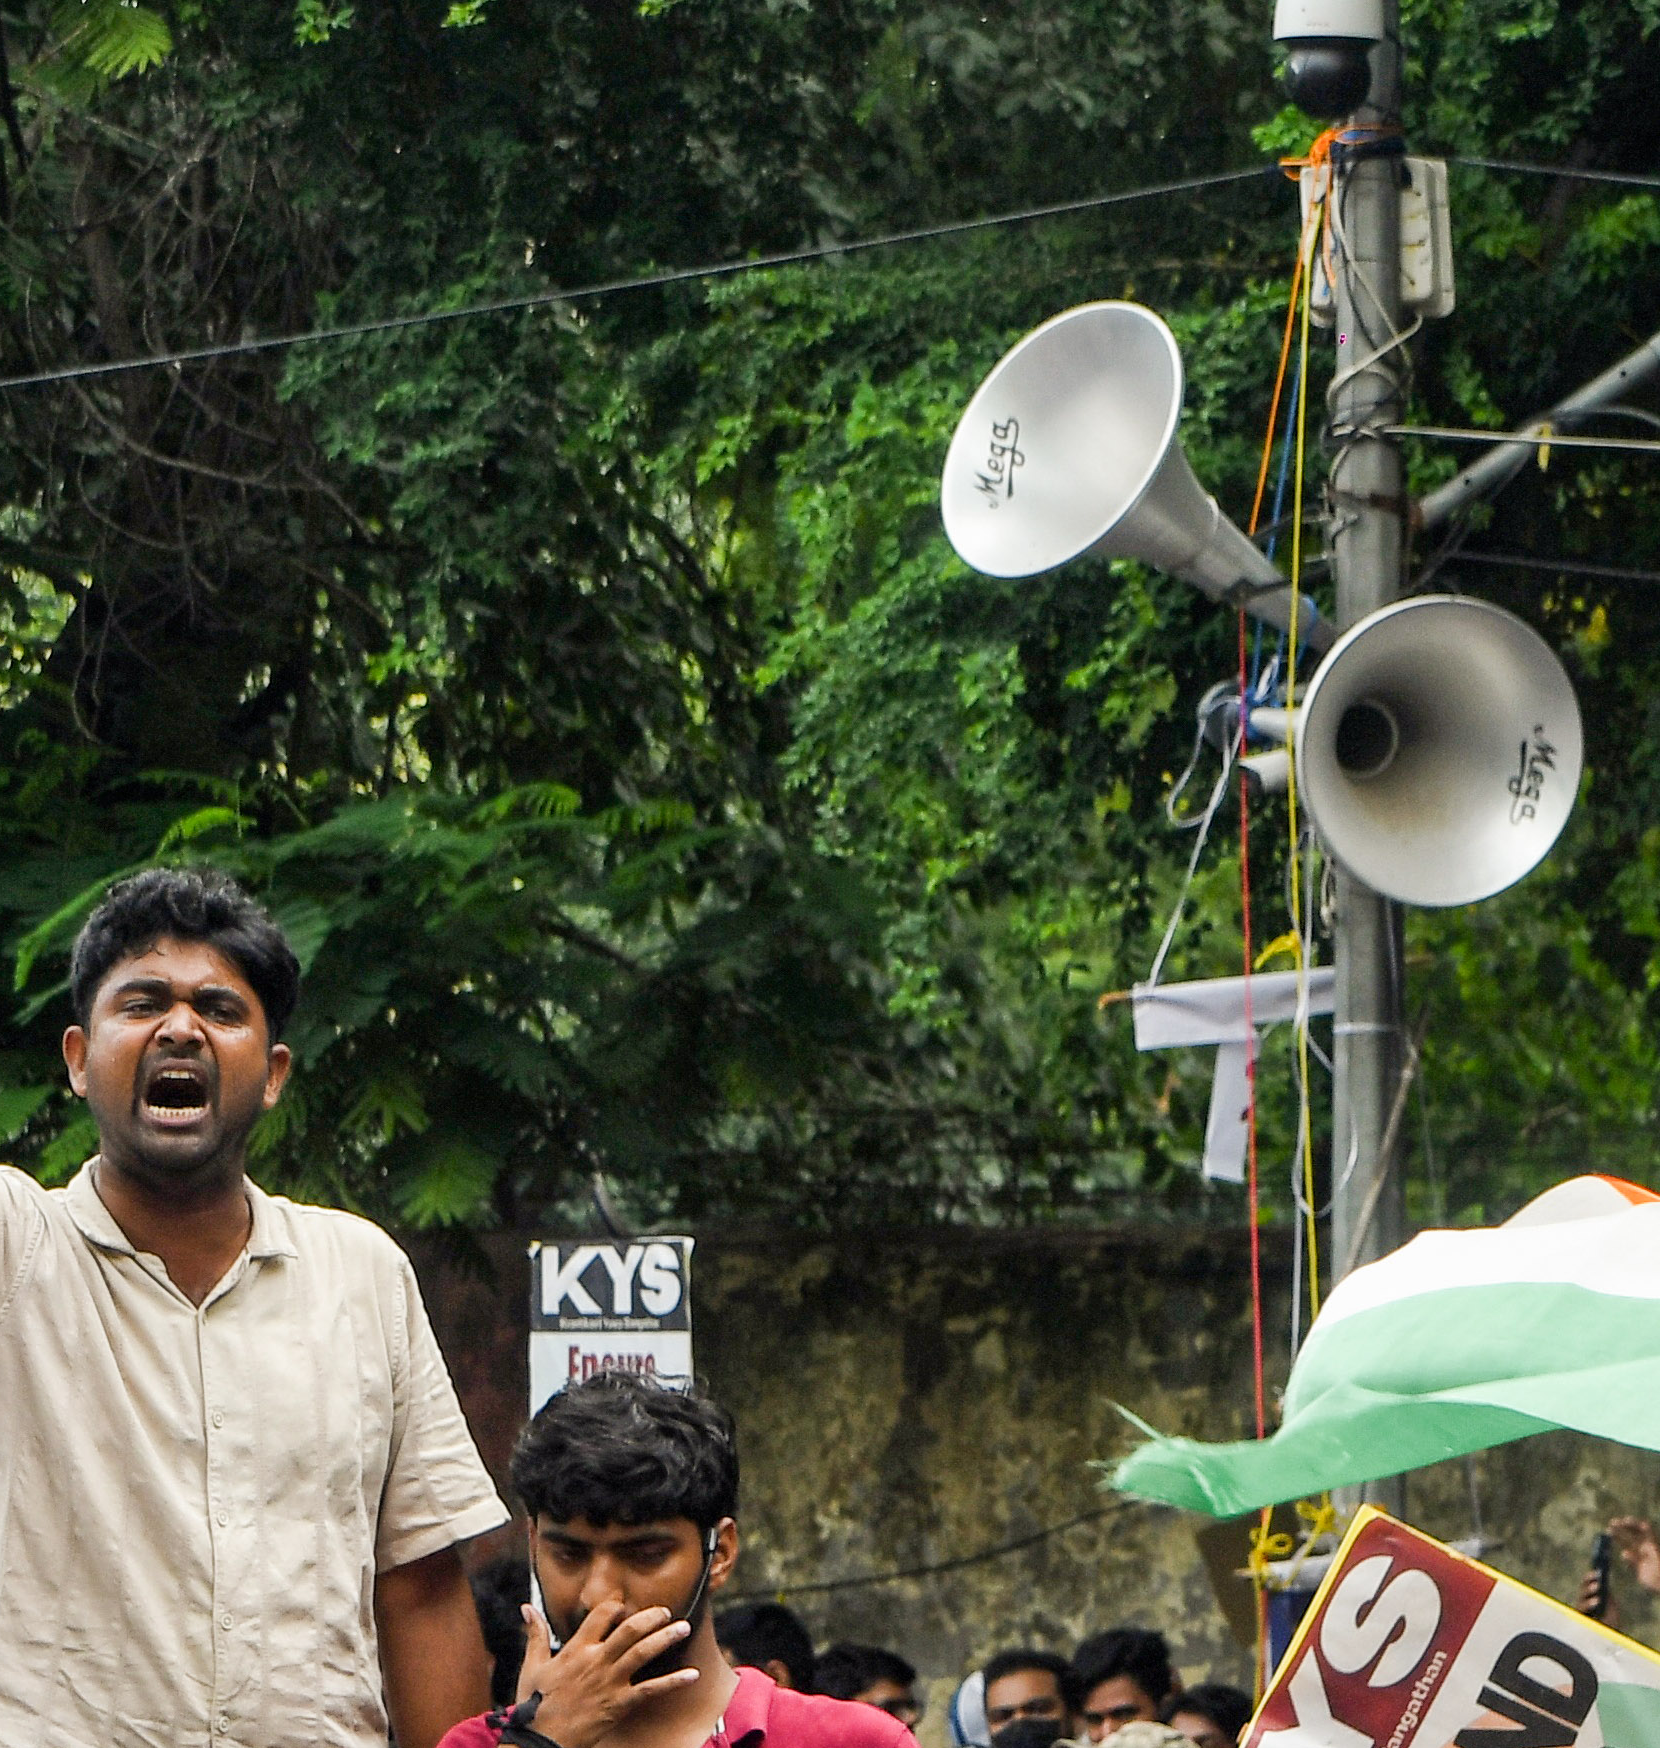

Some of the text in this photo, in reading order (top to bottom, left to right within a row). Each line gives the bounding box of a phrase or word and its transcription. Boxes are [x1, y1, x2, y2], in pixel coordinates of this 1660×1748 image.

[973, 416, 1025, 509] Mega
[1507, 723, 1556, 826] Mega
[541, 1244, 681, 1316] KYS
